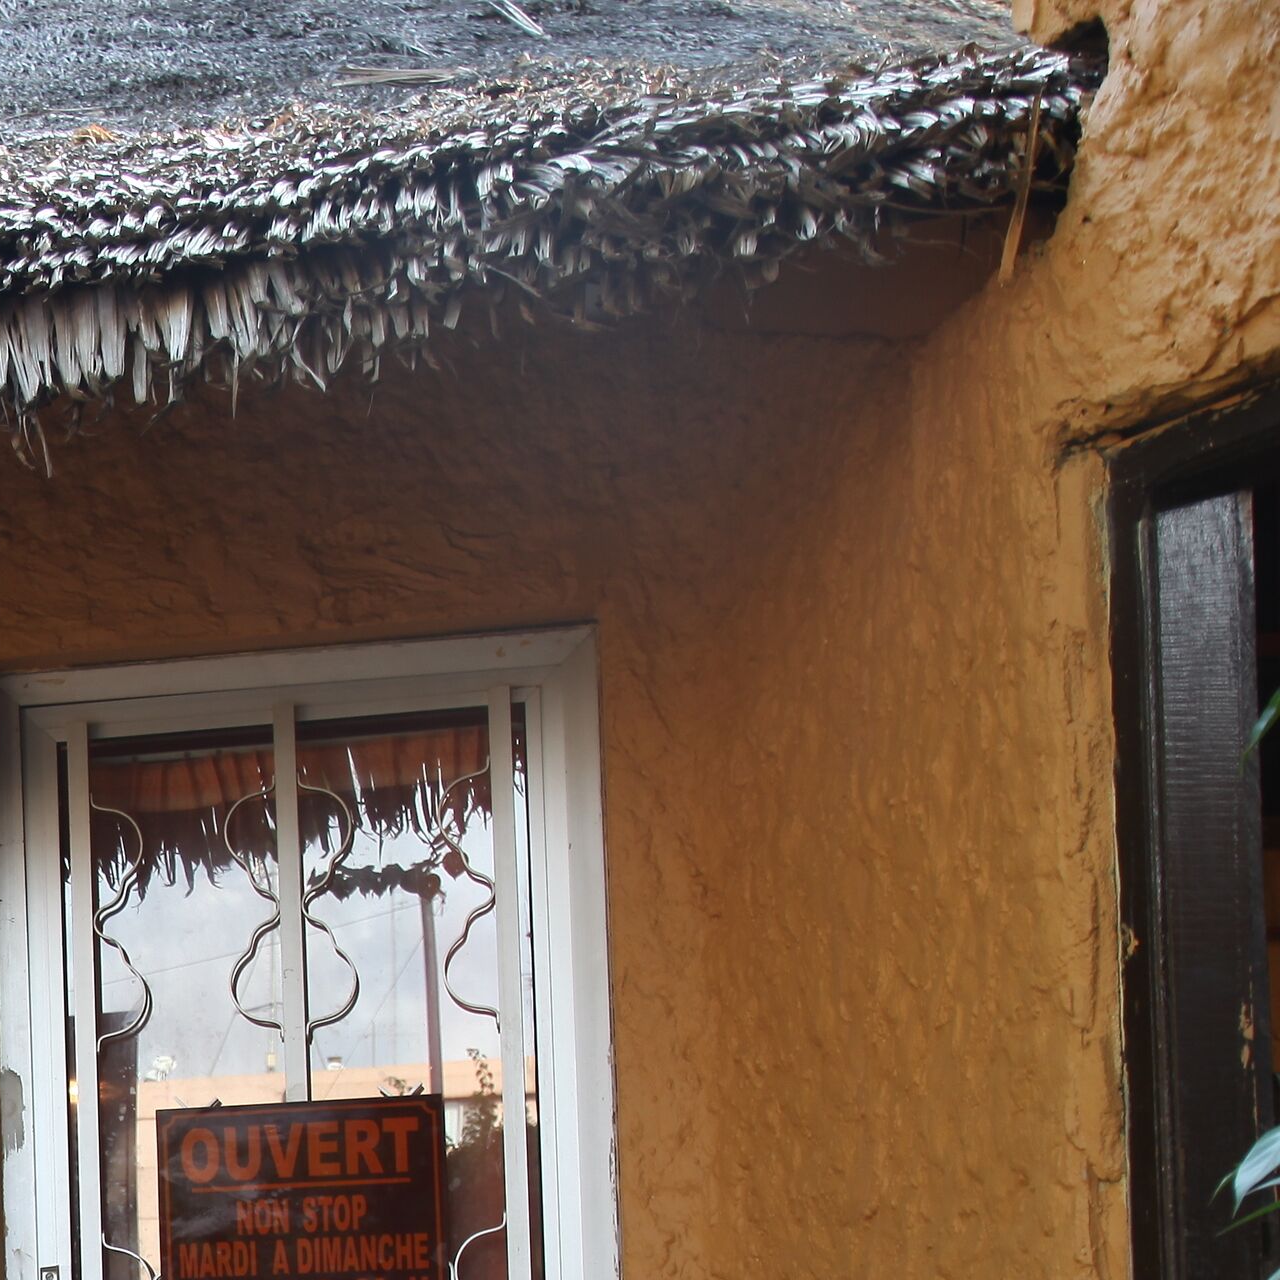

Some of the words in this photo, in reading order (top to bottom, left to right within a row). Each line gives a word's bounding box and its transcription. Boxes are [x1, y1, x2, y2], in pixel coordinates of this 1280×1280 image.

[180, 1116, 419, 1184] OUVERT
[236, 1199, 289, 1235] NON
[302, 1194, 367, 1233] STOP
[179, 1241, 257, 1278] MARDI
[273, 1238, 289, 1274] A
[297, 1233, 429, 1273] DIMANCHE
